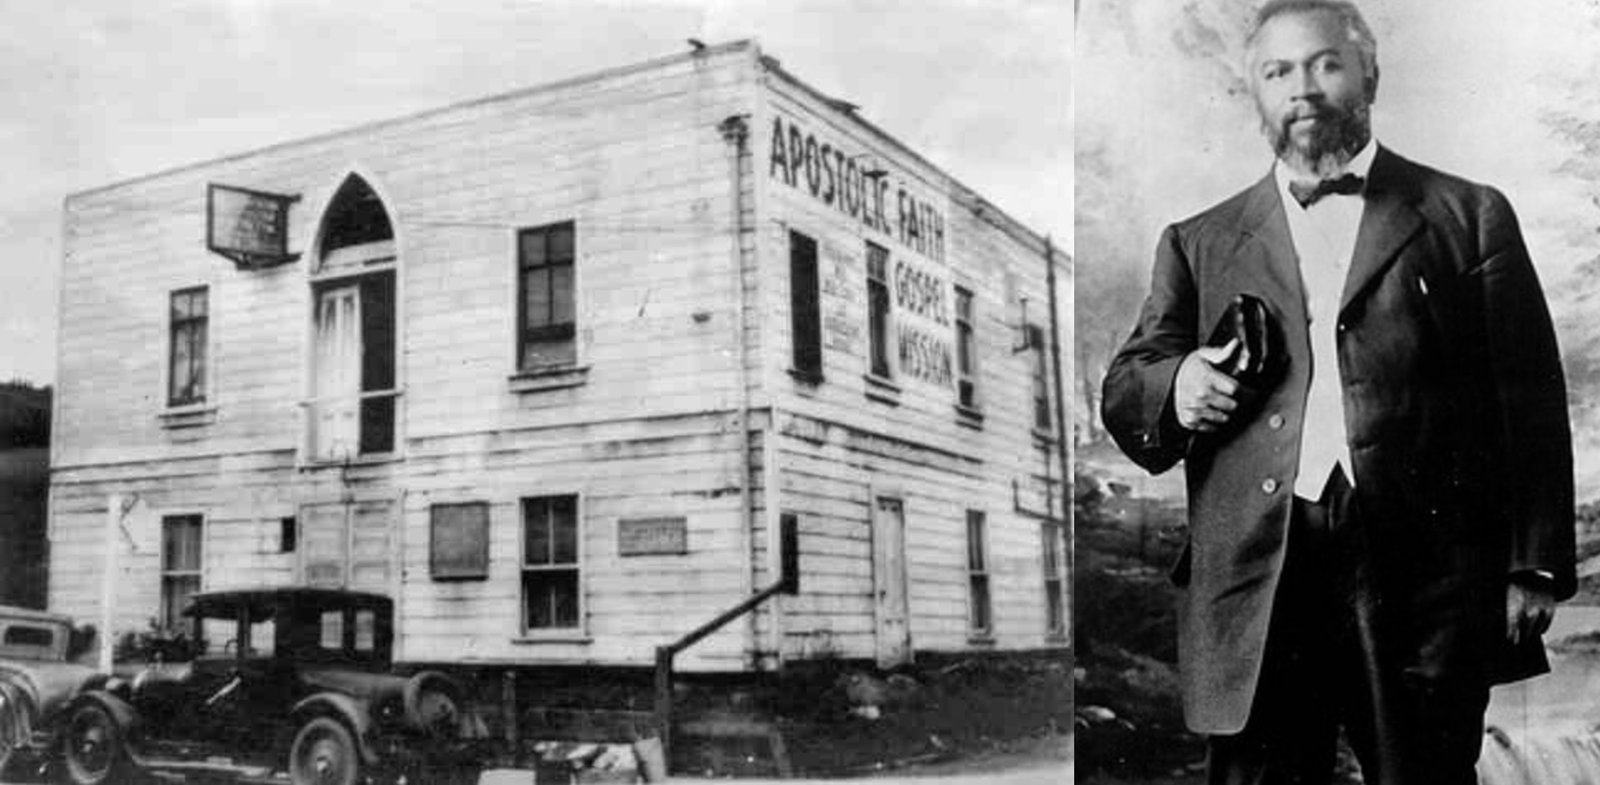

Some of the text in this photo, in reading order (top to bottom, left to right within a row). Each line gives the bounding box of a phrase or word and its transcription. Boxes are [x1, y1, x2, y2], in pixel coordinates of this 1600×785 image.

[769, 115, 946, 263] APOSTOLIC FAITH
[895, 260, 949, 328] GOSPEL
[898, 321, 954, 388] MISSION
